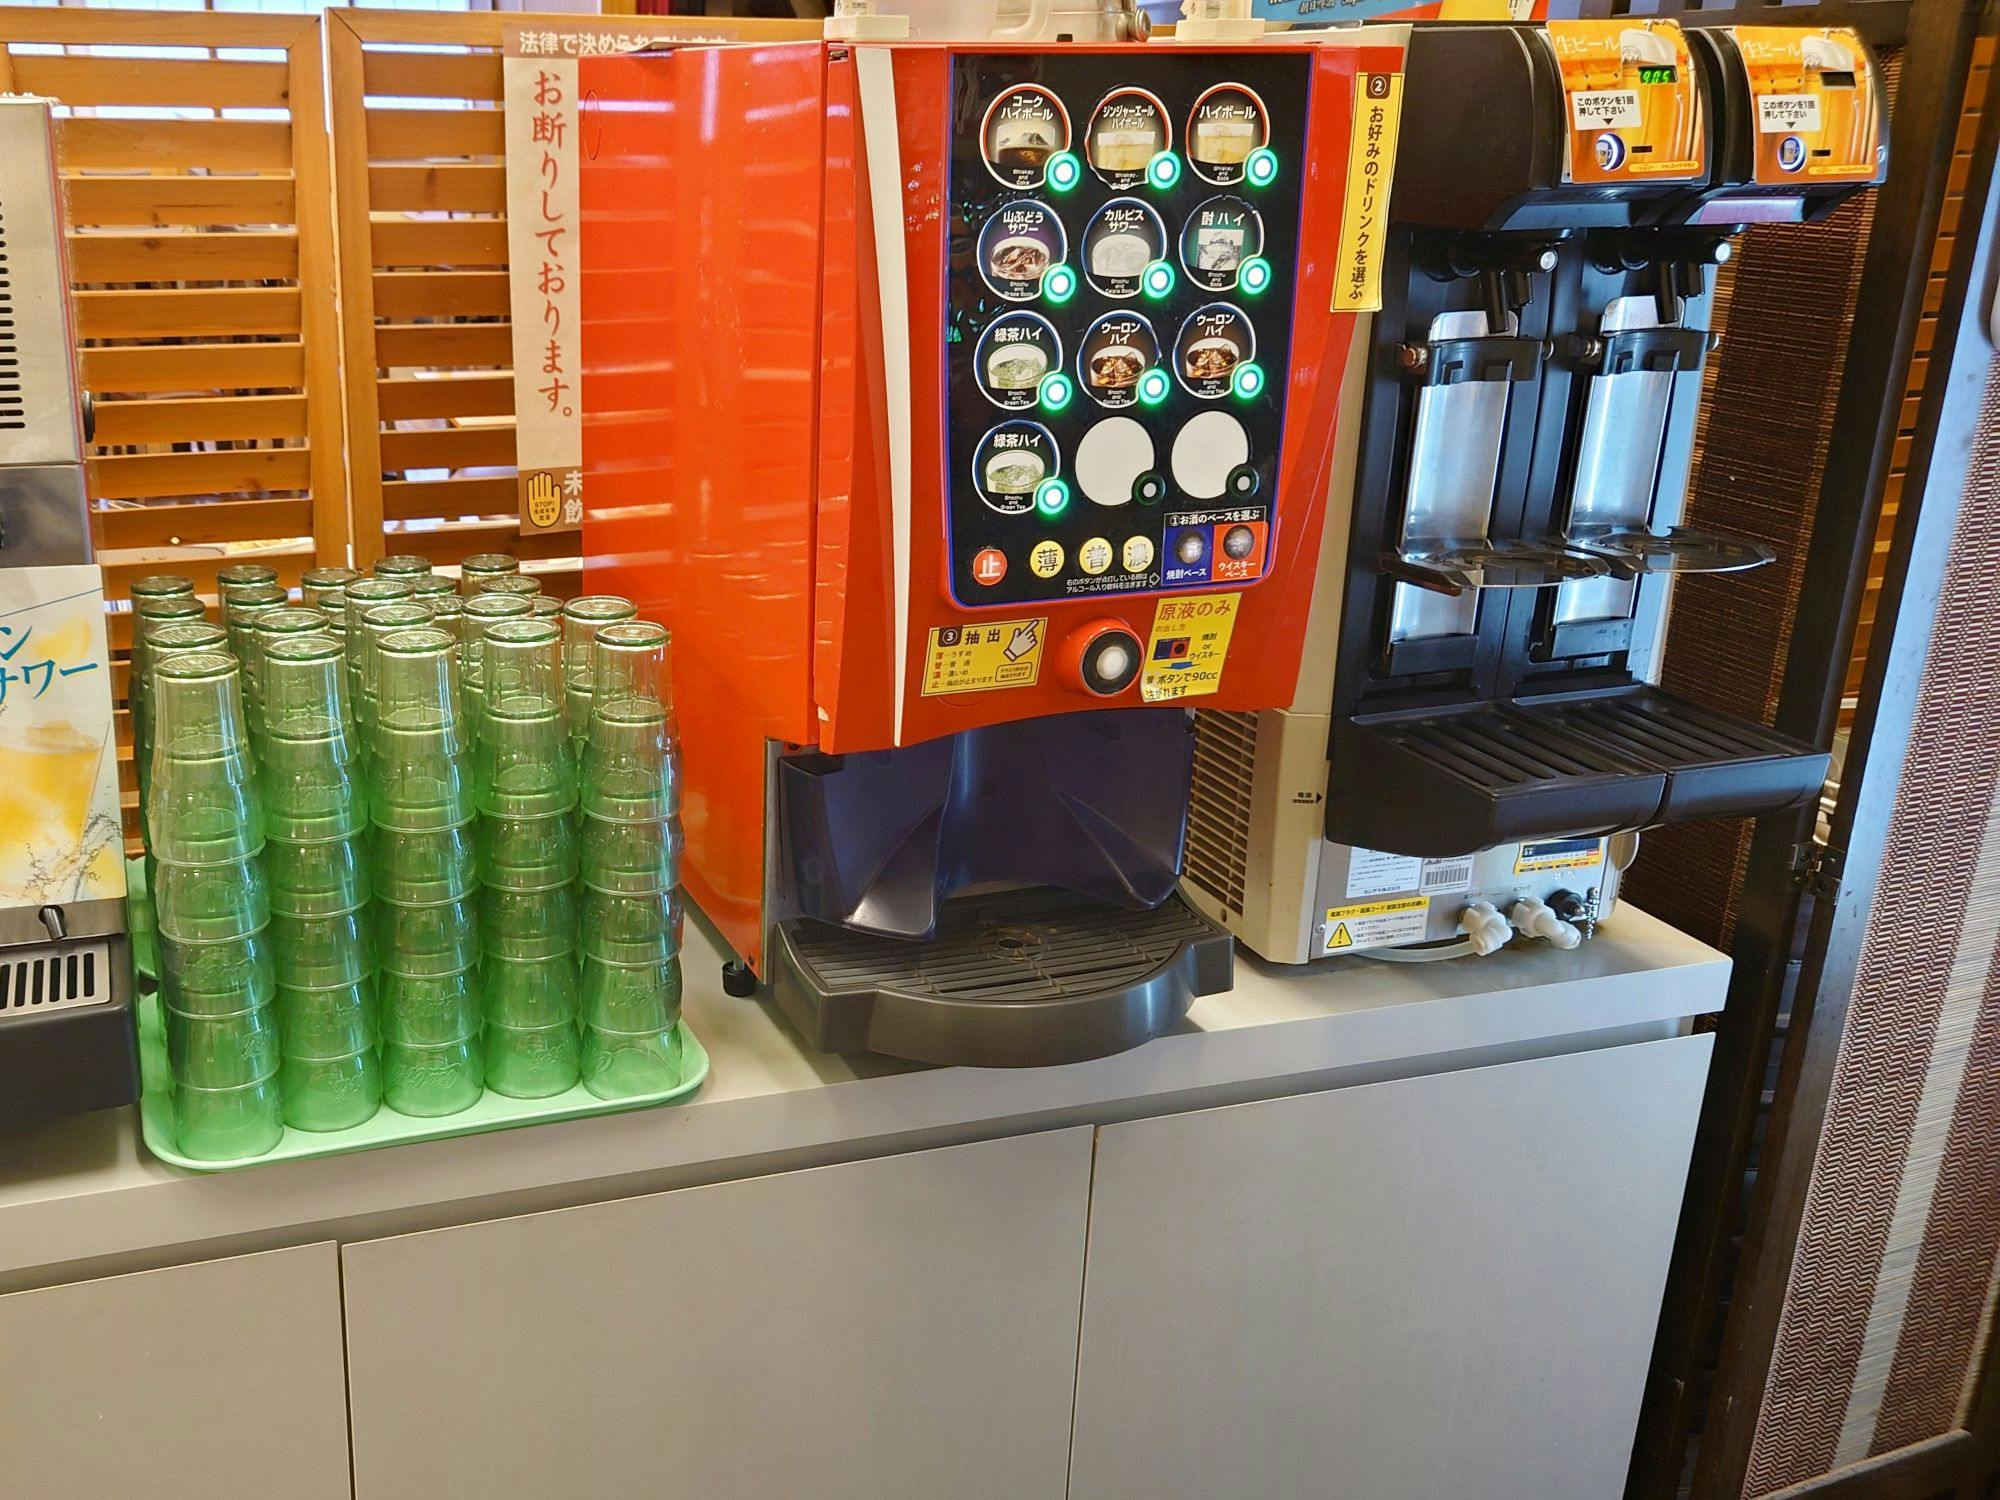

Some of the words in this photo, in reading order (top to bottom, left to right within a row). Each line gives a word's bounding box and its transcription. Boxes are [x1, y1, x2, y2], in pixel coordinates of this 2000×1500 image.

[1012, 95, 1044, 108] コーク
[1577, 95, 1635, 106] このボタンを1回
[1000, 107, 1054, 120] ハイボール
[1102, 105, 1155, 118] ジンジャーエール
[1199, 105, 1257, 120] ハイボール
[1578, 106, 1626, 117] 押して下さい
[1764, 111, 1807, 120] 押して下さい
[1111, 118, 1145, 129] ハイボール
[1349, 105, 1384, 300] お好みのドリンクを選ぶ
[1002, 210, 1044, 223] 山ぶどう
[1104, 209, 1145, 221] カルピス
[1201, 211, 1245, 226] 酎ハイ
[1007, 223, 1039, 235] サワー
[1108, 221, 1139, 233] サワー
[532, 70, 573, 417] お断りしております。
[1196, 314, 1236, 326] ウーロン
[1101, 322, 1141, 334] ウーロン
[1204, 325, 1225, 337] ハイ
[994, 327, 1043, 342] 緑茶ハイ
[1109, 333, 1131, 345] ハイ
[993, 433, 1042, 448] 緑茶ハイ
[978, 554, 1000, 578] 止
[1037, 548, 1059, 572] 薄
[1218, 561, 1256, 570] ウイスキー
[1166, 568, 1206, 580] 焼酎ベース
[1225, 569, 1248, 577] ベース
[1158, 599, 1231, 620] 原液のみ
[1155, 624, 1185, 632] の出し方
[965, 629, 1000, 645] 抽出
[1189, 651, 1221, 660] ウイスキー
